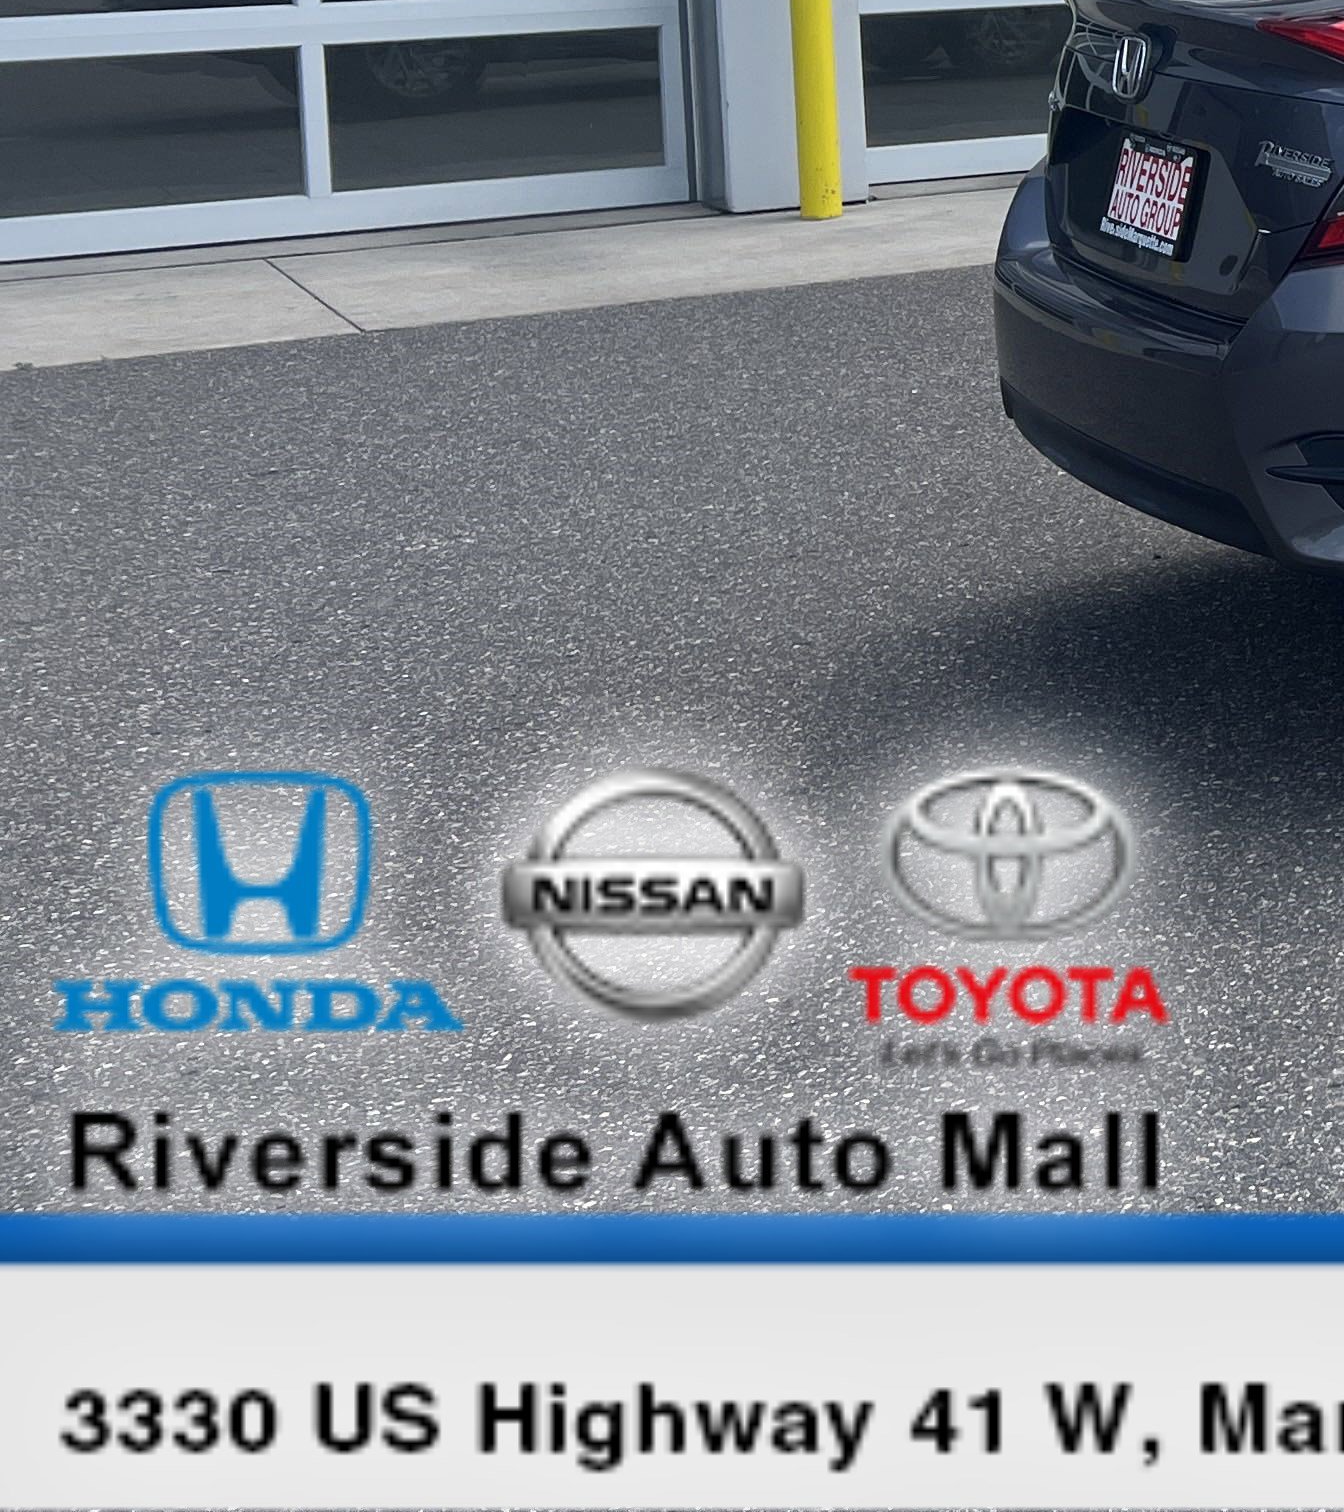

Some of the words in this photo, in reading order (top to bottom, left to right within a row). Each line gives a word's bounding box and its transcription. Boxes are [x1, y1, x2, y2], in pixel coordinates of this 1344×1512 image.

[1115, 148, 1194, 205] RIVERSIDE
[1255, 140, 1334, 170] RIVERSIDE
[1110, 188, 1141, 224] AUTO
[1140, 197, 1183, 238] GROUP
